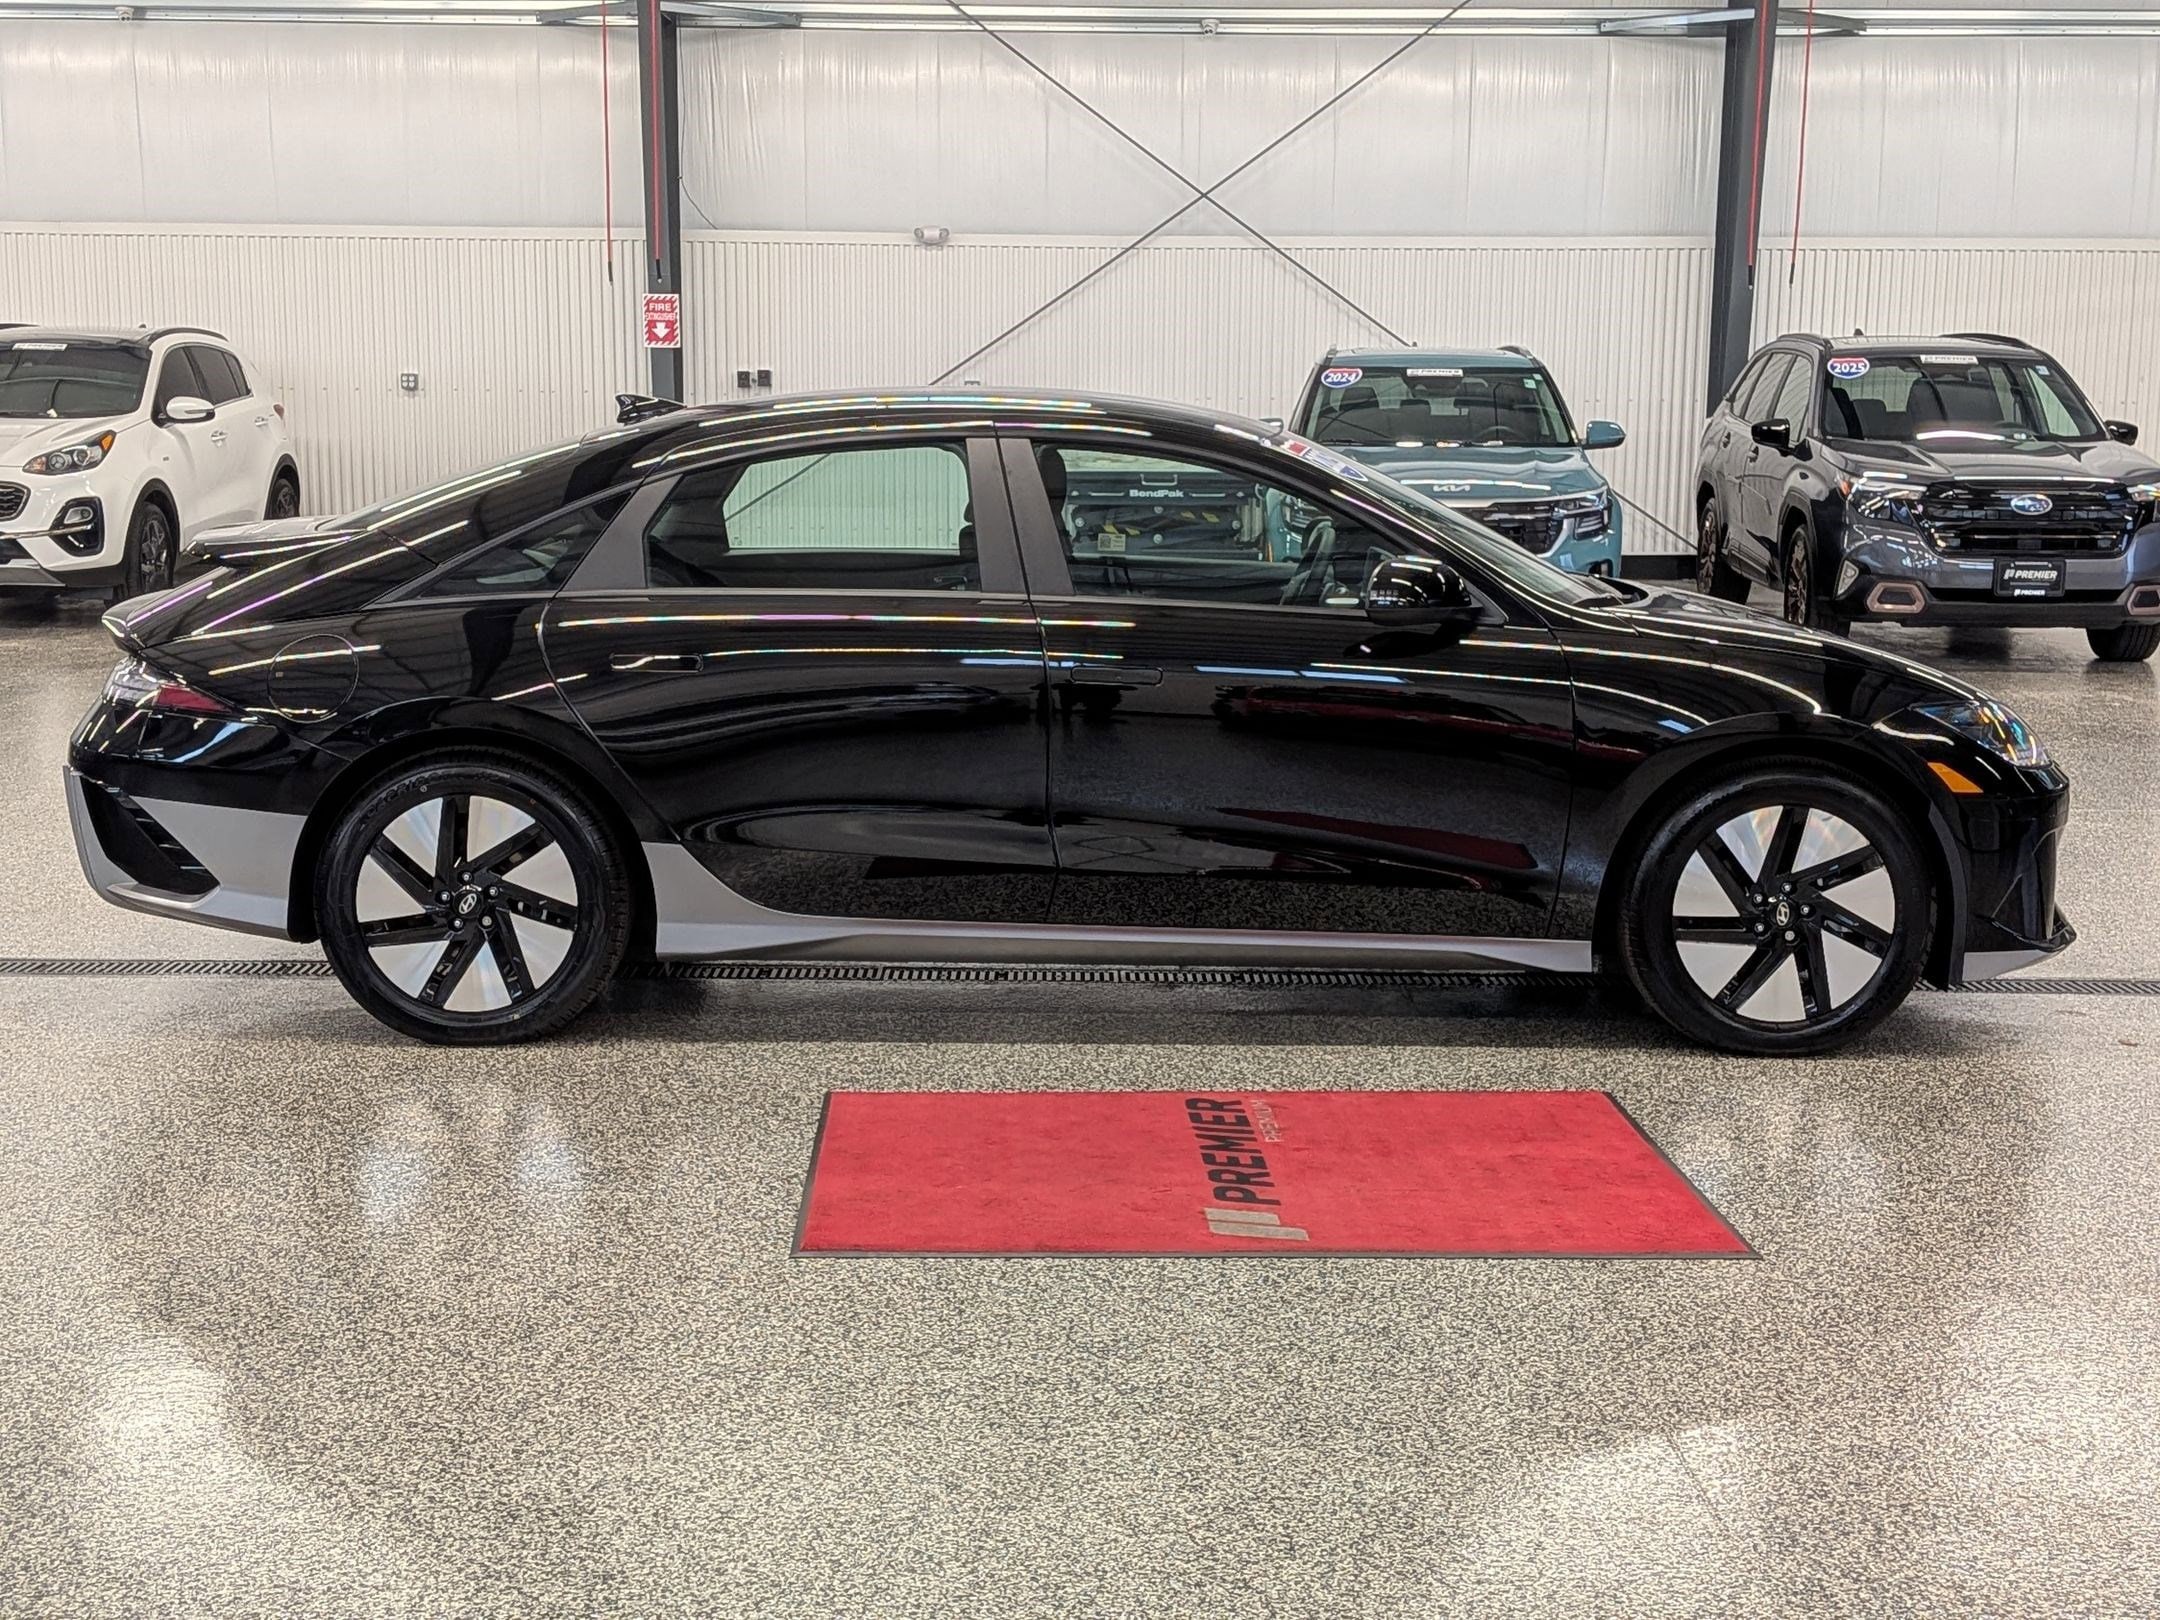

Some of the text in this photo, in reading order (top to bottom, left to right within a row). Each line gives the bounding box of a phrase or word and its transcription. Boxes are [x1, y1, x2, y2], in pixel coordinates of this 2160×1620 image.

[649, 302, 672, 311] FIRE
[1833, 363, 1865, 373] 2025
[1326, 372, 1357, 383] 2024
[1129, 489, 1184, 498] BendPak
[2014, 570, 2058, 579] PREMIER
[1185, 1098, 1281, 1206] PREMIER
